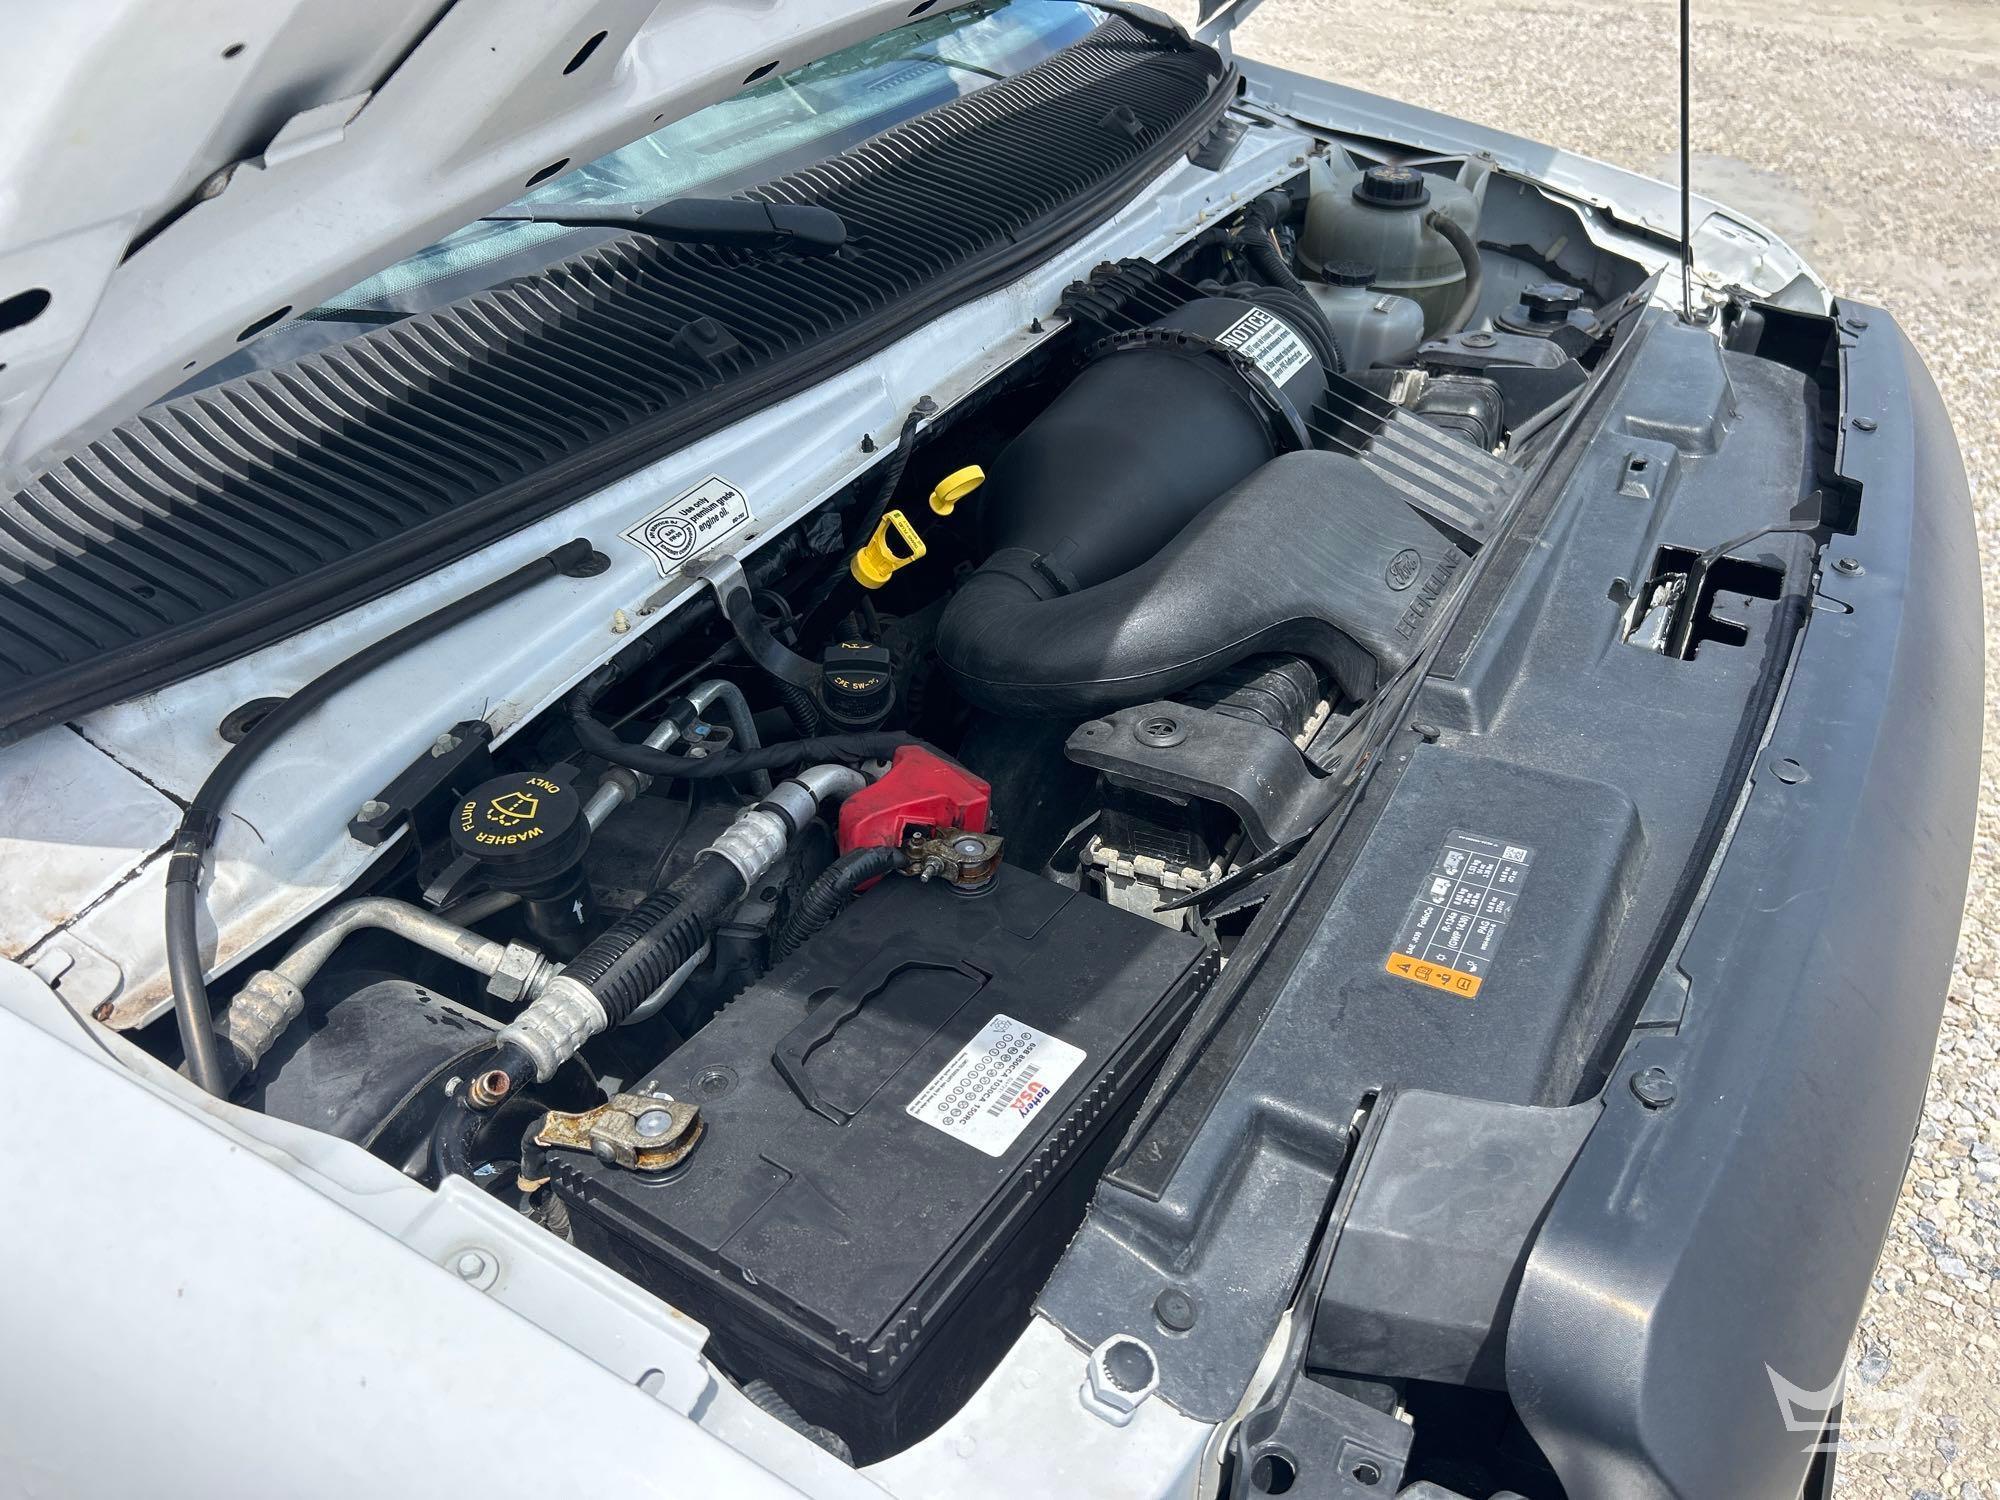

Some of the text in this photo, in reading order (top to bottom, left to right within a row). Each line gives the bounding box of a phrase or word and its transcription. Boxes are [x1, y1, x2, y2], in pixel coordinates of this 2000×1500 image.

[1222, 311, 1270, 348] NOTICE
[679, 496, 710, 516] Use only
[689, 490, 736, 524] premium grade
[699, 507, 730, 532] engine oil.
[461, 777, 561, 845] WASHER FLUID ONLY
[1023, 1042, 1037, 1055] 65B
[1001, 1054, 1025, 1078] 850CCA
[979, 1079, 1003, 1102] 1030CA
[1010, 1081, 1042, 1109] USA
[1018, 1087, 1050, 1119] Battery
[959, 1104, 980, 1125] 150RC
